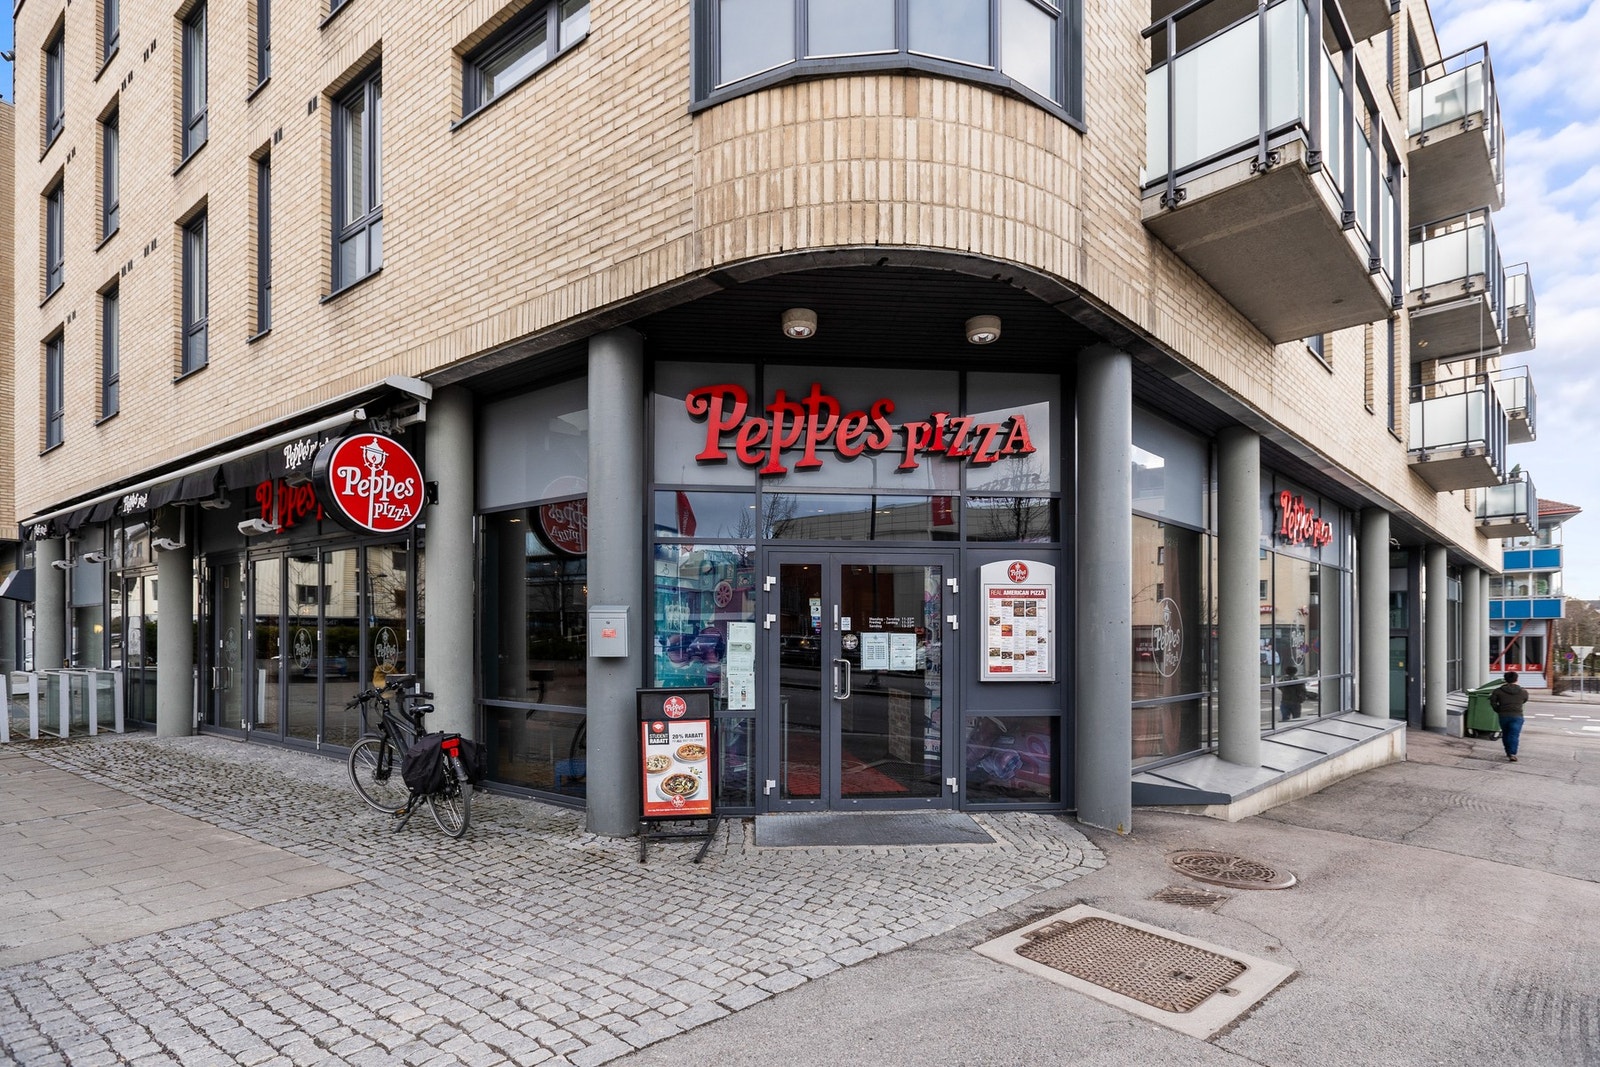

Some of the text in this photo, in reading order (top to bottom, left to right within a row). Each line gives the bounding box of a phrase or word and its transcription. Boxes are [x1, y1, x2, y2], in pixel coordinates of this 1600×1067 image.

[685, 382, 895, 474] Peppes
[283, 438, 311, 470] Peppes
[256, 478, 316, 534] Pppes
[337, 466, 415, 502] Peppes
[1280, 489, 1314, 545] Peppes
[1154, 624, 1180, 652] Peppes
